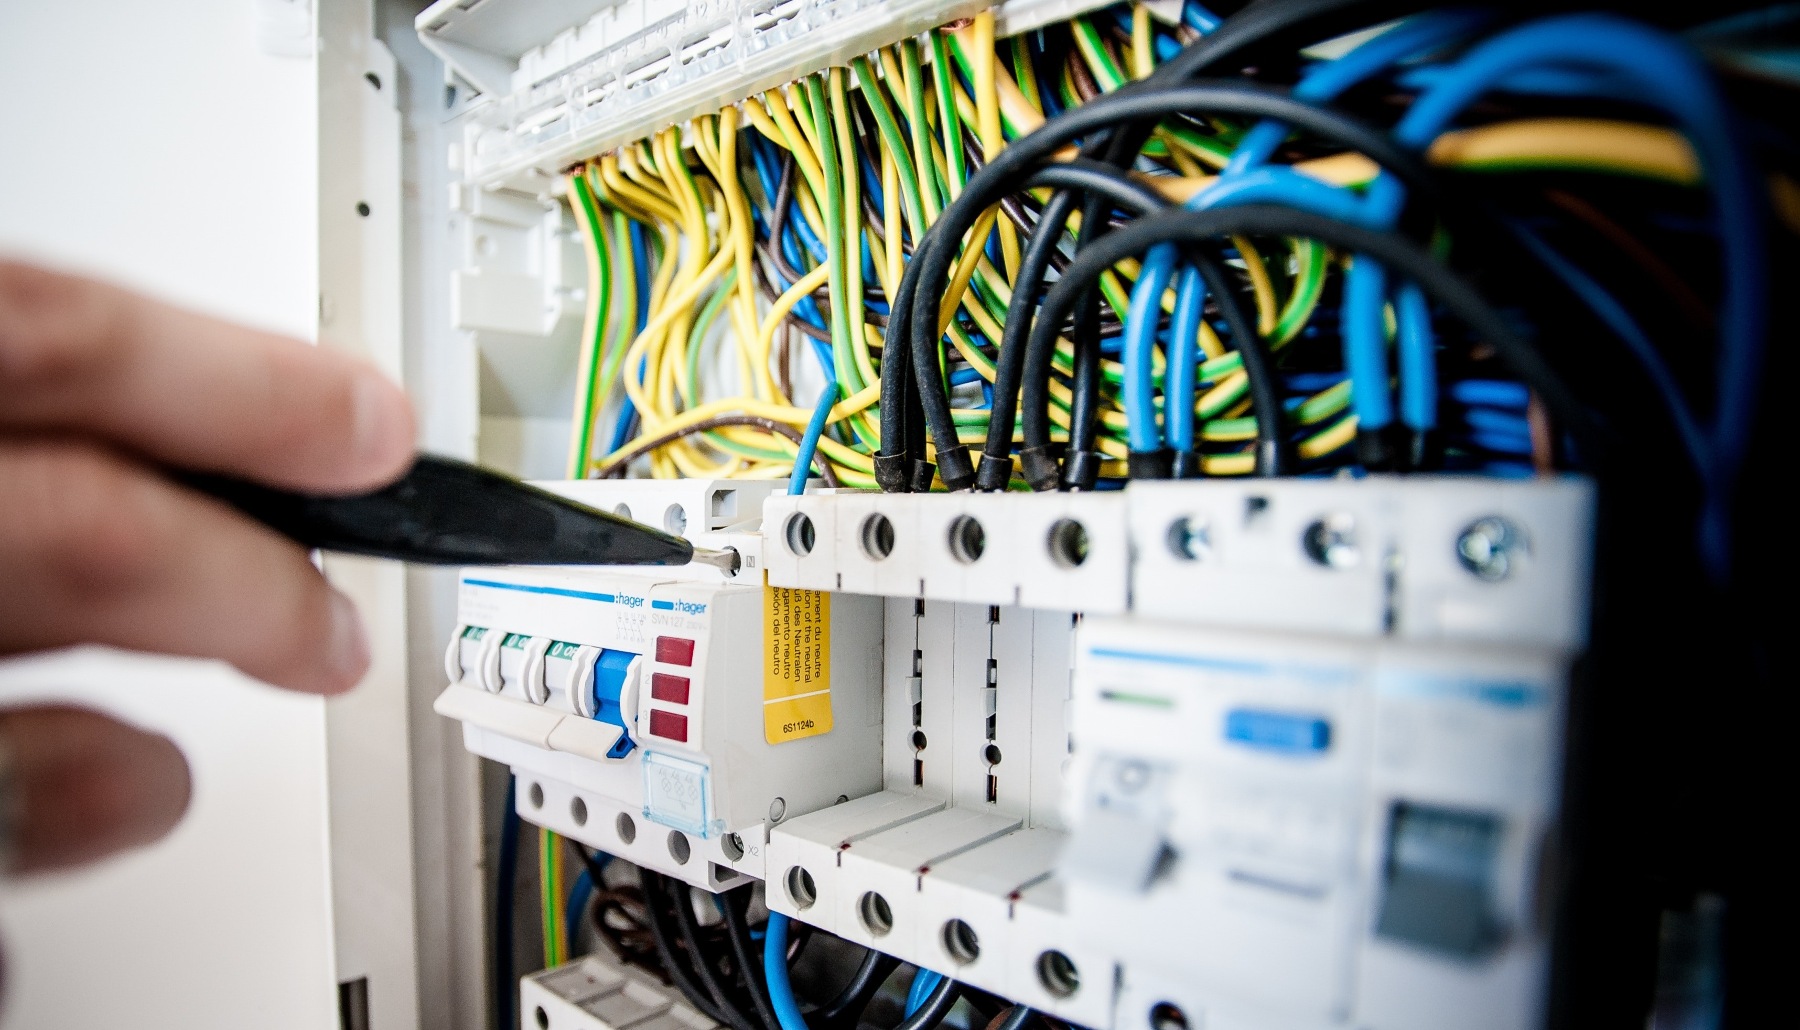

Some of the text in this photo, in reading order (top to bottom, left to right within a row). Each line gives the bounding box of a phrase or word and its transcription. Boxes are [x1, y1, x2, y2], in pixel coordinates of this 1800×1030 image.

[805, 612, 811, 623] of
[773, 619, 781, 635] del
[814, 627, 821, 640] du
[783, 719, 814, 733] 6S1124b
[748, 844, 759, 856] X2
